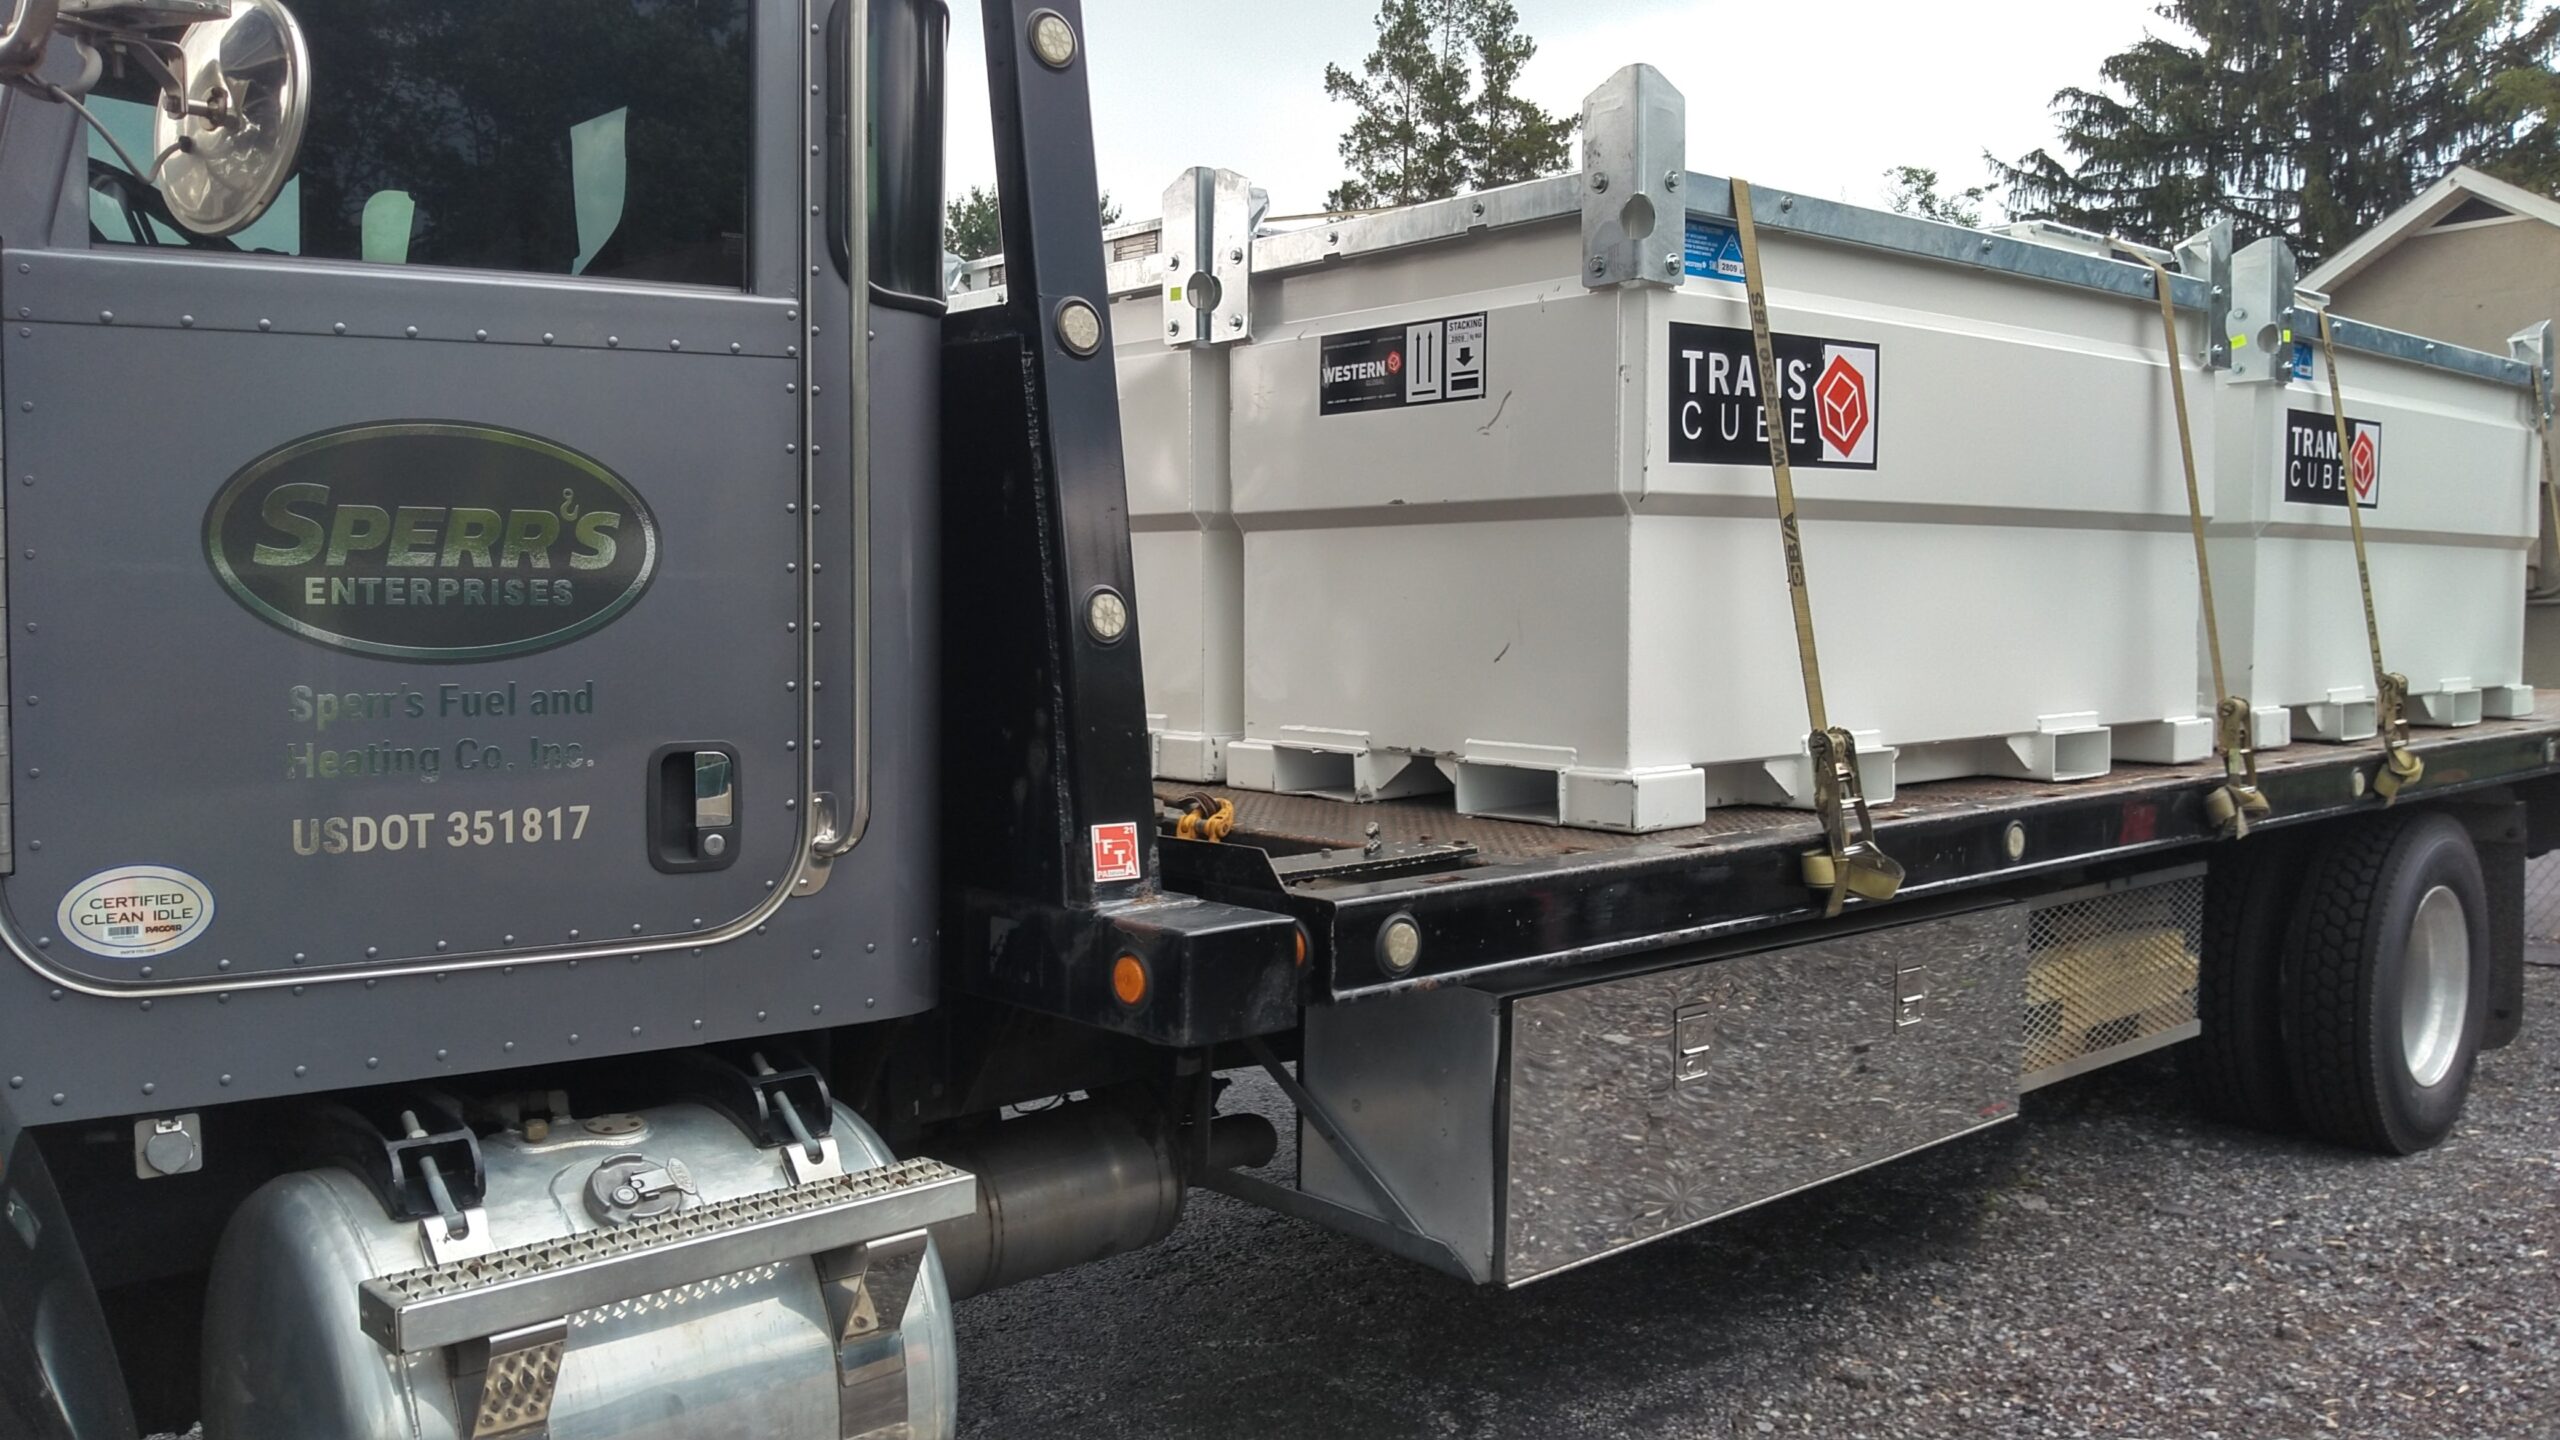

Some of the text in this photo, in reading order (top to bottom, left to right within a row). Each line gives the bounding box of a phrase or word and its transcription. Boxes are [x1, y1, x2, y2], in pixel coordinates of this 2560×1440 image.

[1721, 262, 1738, 272] 2809
[1448, 318, 1483, 332] STACKING
[1751, 291, 1770, 340] LBS
[1322, 360, 1386, 383] WESTERN
[1682, 349, 1807, 400] TRAS
[1769, 414, 1786, 467] WLL
[2291, 426, 2344, 461] TRAN
[2290, 460, 2347, 491] CUBE
[304, 576, 574, 606] ENTERPRISES
[288, 679, 594, 731] Sperr's Fuel and
[286, 735, 595, 783] Heating Co. Inc.
[292, 805, 591, 856] USDOT 351817
[1123, 826, 1134, 834] 21
[80, 908, 193, 926] CLEAN IDLE
[89, 893, 184, 910] CERTIFIED
